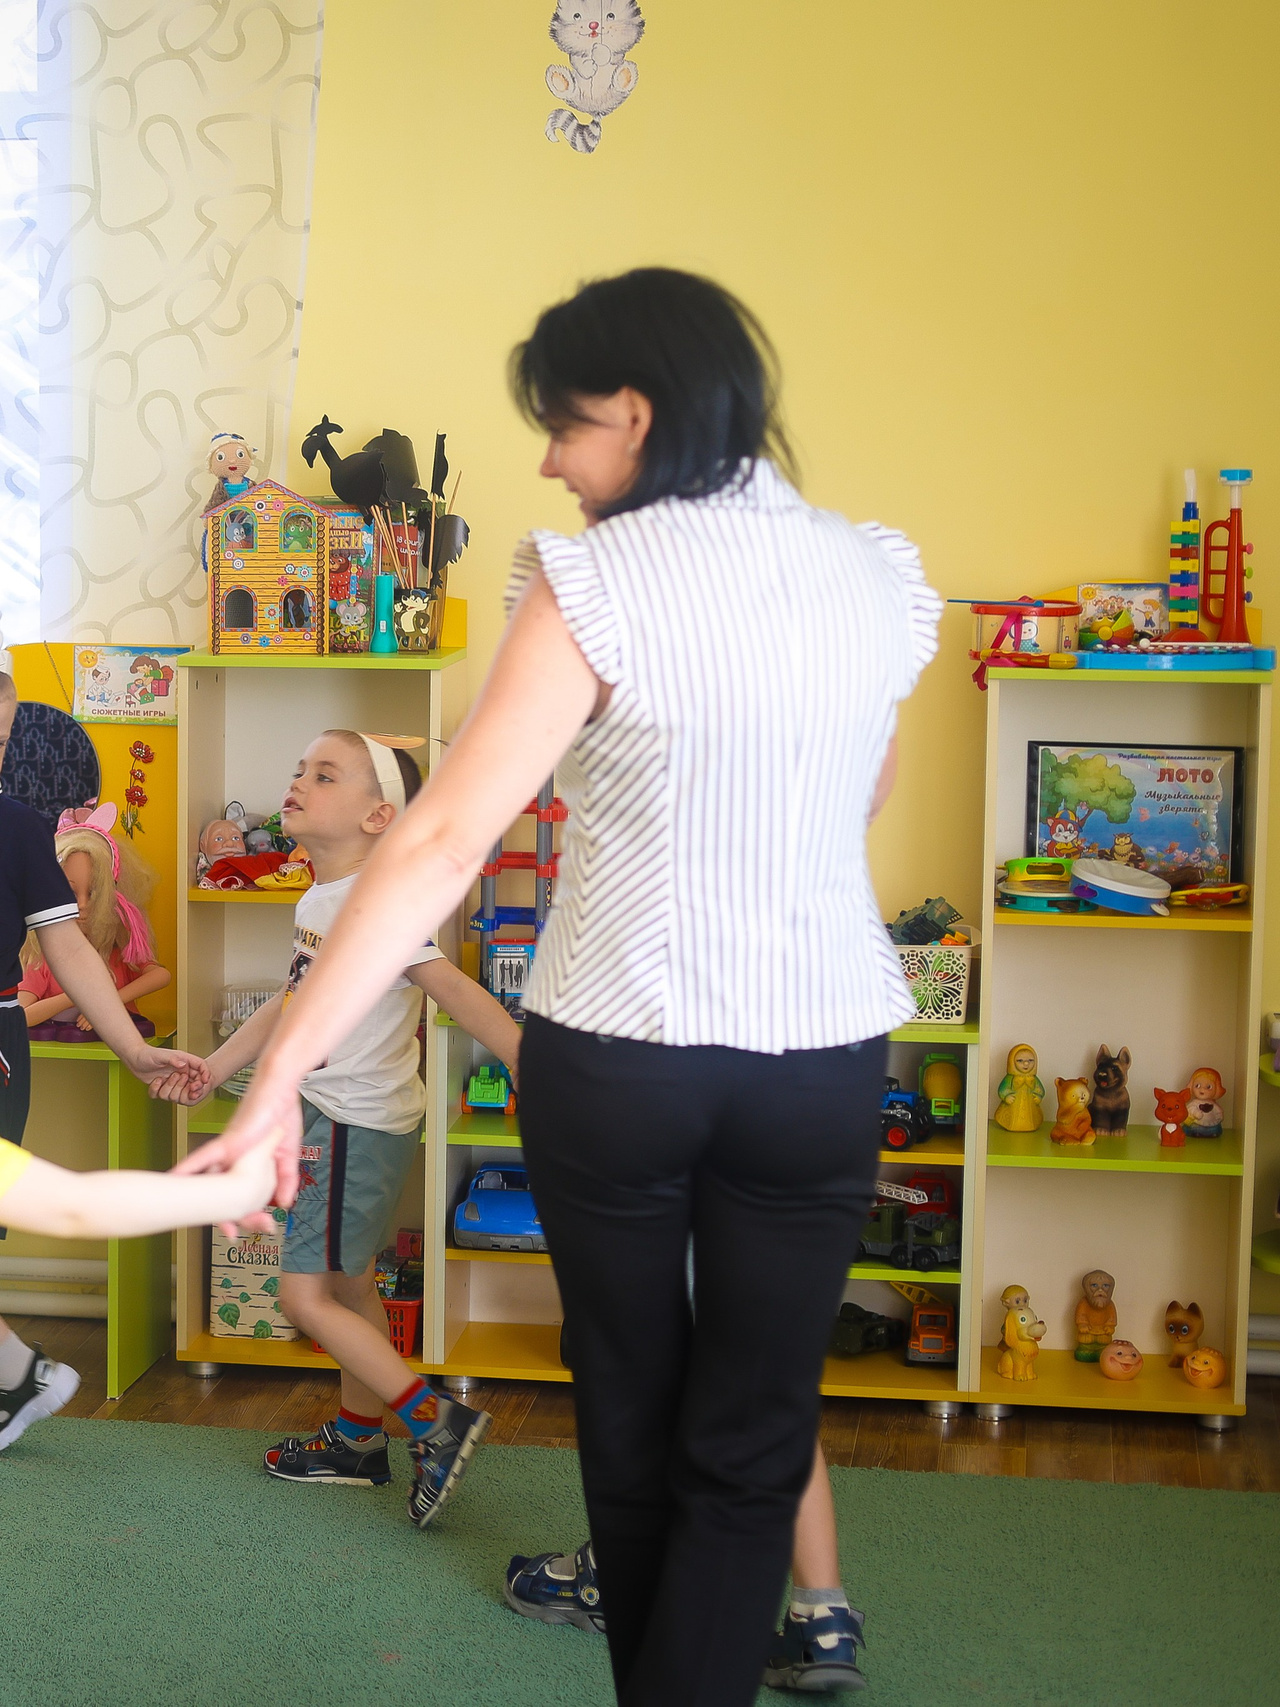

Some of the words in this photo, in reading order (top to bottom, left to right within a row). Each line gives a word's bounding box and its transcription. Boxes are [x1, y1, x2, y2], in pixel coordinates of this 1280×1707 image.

[91, 708, 141, 716] СЮЖЕТНЫЕ
[1156, 767, 1214, 783] ЛОТО
[1144, 790, 1221, 802] Музыкальные
[238, 1240, 279, 1254] Лесная
[227, 1246, 279, 1267] Сказка
